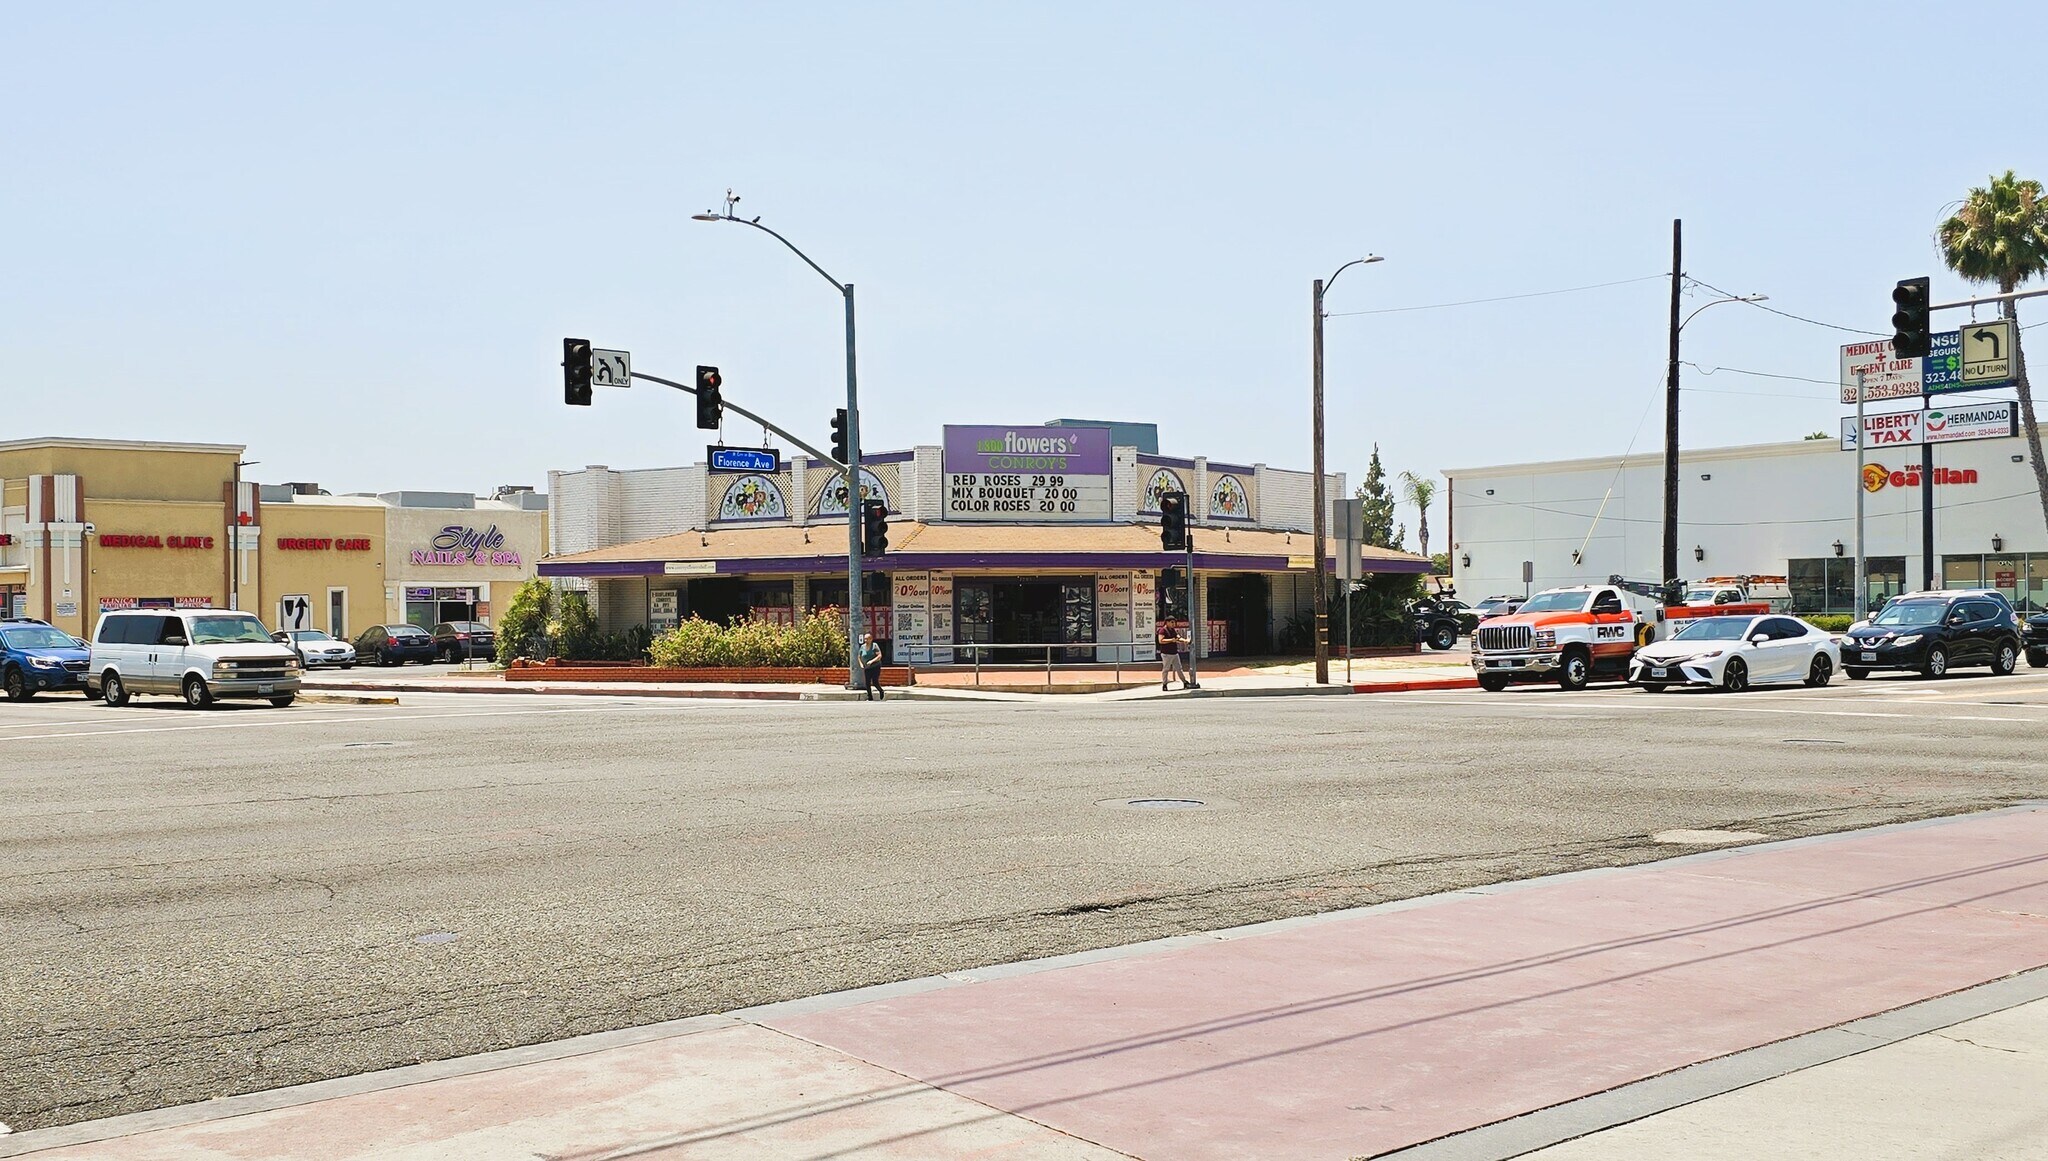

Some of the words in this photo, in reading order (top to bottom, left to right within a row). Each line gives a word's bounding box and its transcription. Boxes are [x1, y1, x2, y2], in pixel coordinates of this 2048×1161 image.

[1846, 342, 1885, 356] MEDICAL
[1850, 362, 1886, 376] UGENT
[1889, 359, 1913, 371] CARE
[1965, 367, 1976, 375] NO
[1977, 365, 1986, 375] U
[1986, 364, 2007, 373] TURN
[613, 377, 629, 385] ONLY
[1843, 381, 1920, 401] 32.553.9333
[1864, 413, 1921, 430] LIBERTY
[1947, 409, 2009, 424] HERMANDAD
[1004, 431, 1067, 453] flowers
[1870, 429, 1913, 443] TAX
[718, 455, 750, 467] Florence
[753, 457, 770, 468] Ave
[953, 475, 977, 486] RED
[984, 475, 1021, 486] ROSES
[1032, 476, 1046, 486] 29
[1049, 475, 1064, 487] 99
[1889, 467, 1978, 487] Gailan
[952, 487, 973, 499] MIX
[979, 488, 1036, 500] BOUQUET
[1045, 488, 1059, 500] 20
[1062, 489, 1078, 500] 00
[951, 500, 990, 512] COLOR
[994, 500, 1031, 511] ROSES
[1039, 501, 1055, 512] 20
[1060, 501, 1076, 512] 00
[99, 534, 164, 548] MEDICAL
[166, 536, 214, 549] CLINIC
[277, 538, 333, 551] URGENT
[335, 539, 371, 551] CARE
[432, 524, 506, 559] Style
[410, 550, 466, 565] NAILS
[474, 552, 488, 565] &
[491, 551, 523, 565] SPA
[1098, 583, 1117, 593] 20%
[1597, 626, 1625, 638] RWC
